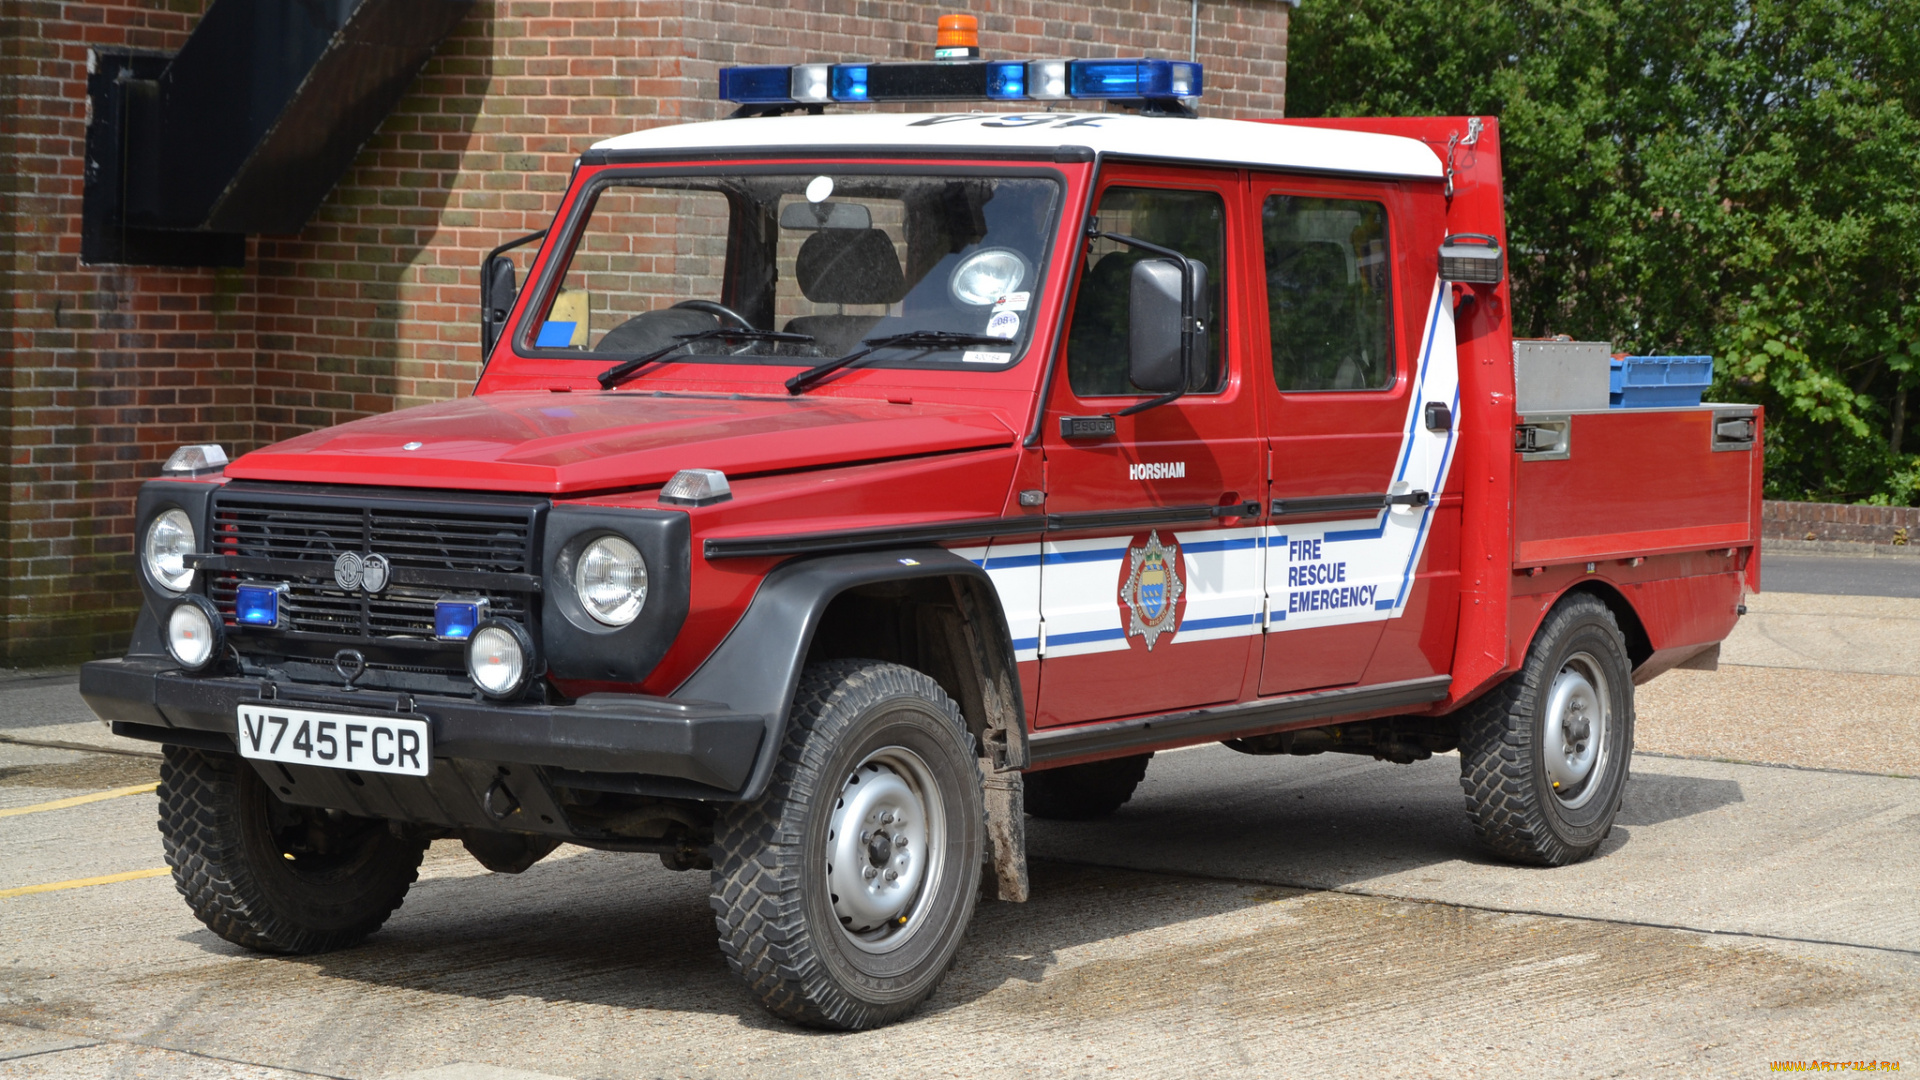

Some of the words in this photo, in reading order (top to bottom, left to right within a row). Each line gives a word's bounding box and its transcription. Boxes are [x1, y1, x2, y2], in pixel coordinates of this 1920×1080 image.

[1129, 461, 1186, 480] HORSHAM
[1289, 538, 1322, 562] FIRE
[364, 560, 383, 568] PUCH
[1288, 562, 1346, 587] RESCUE
[1288, 584, 1378, 613] EMERGENCY
